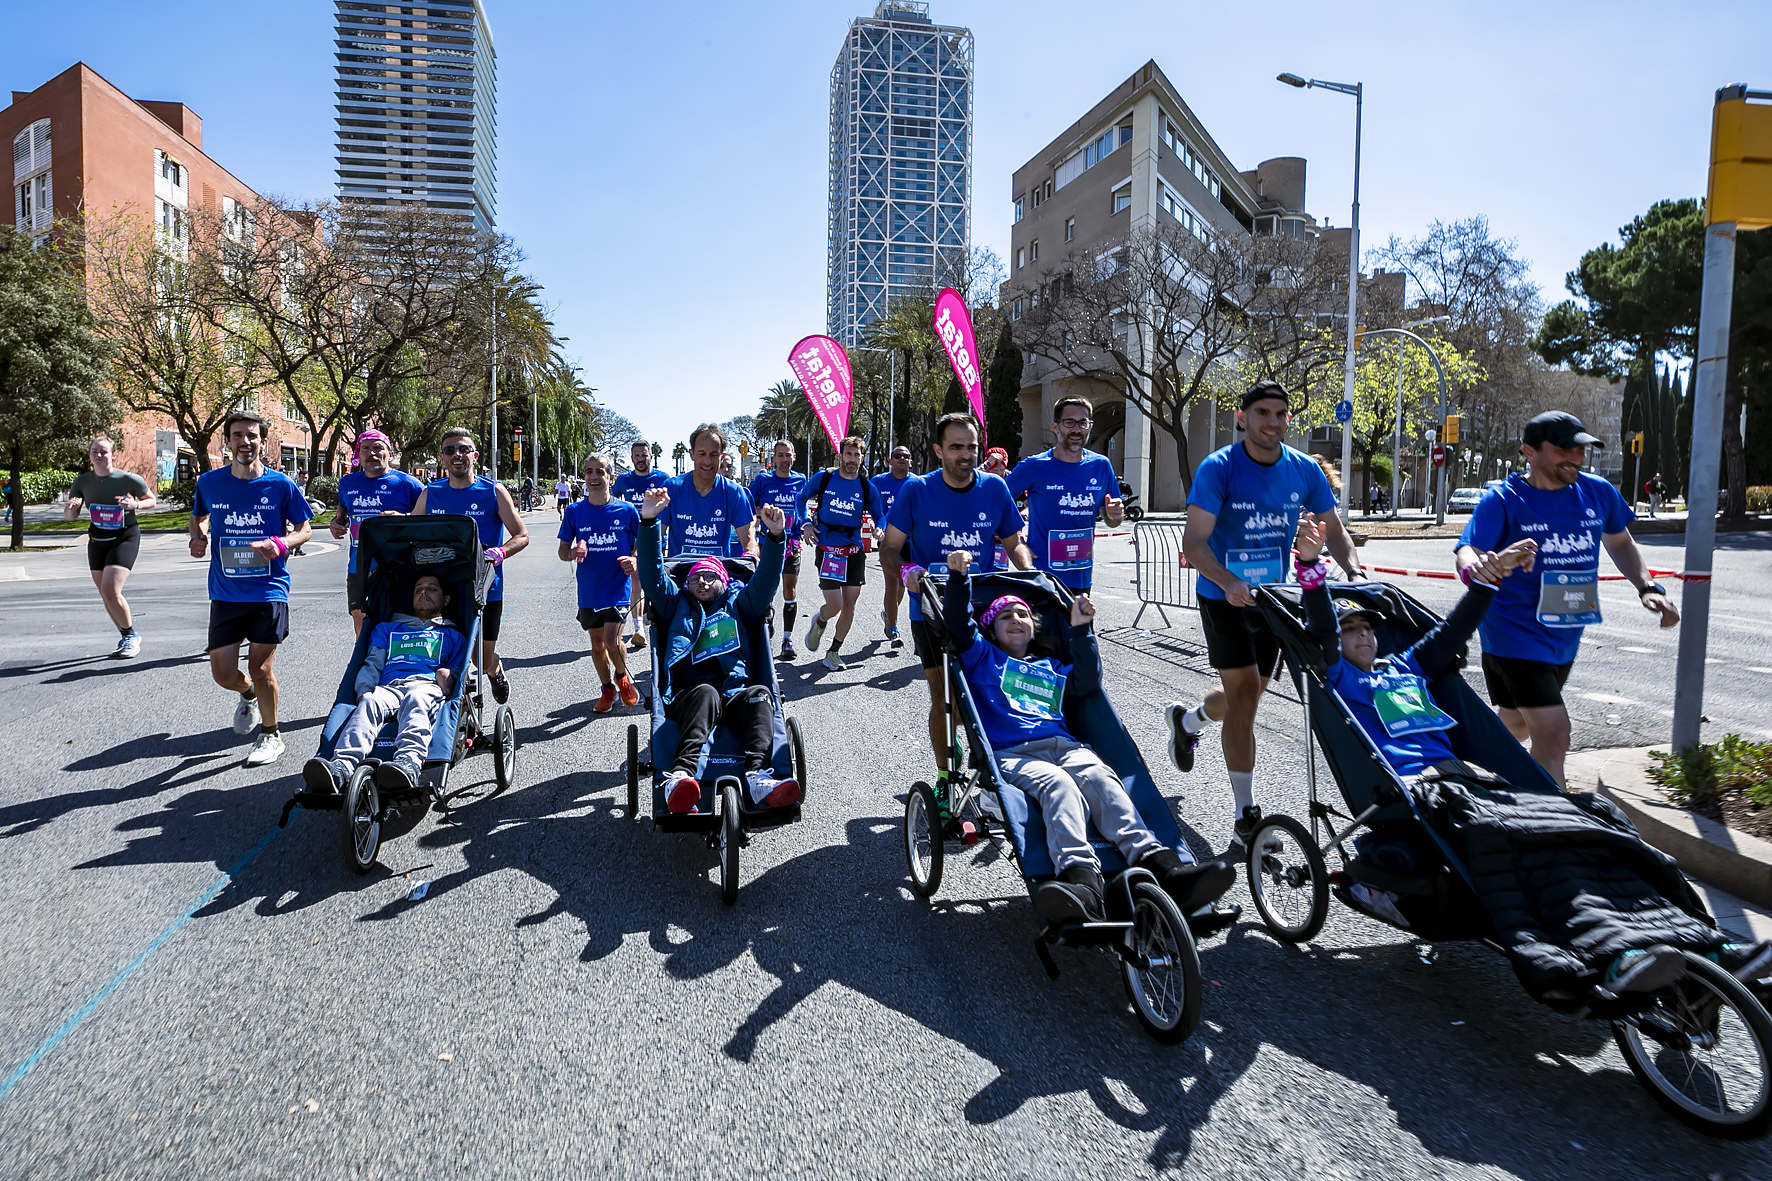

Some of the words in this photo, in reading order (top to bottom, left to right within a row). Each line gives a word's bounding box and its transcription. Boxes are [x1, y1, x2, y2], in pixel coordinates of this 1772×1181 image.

[1232, 502, 1256, 510] aefat
[1520, 522, 1549, 532] aefat
[1543, 555, 1594, 566] #imparables
[1030, 670, 1054, 680] ZURICH
